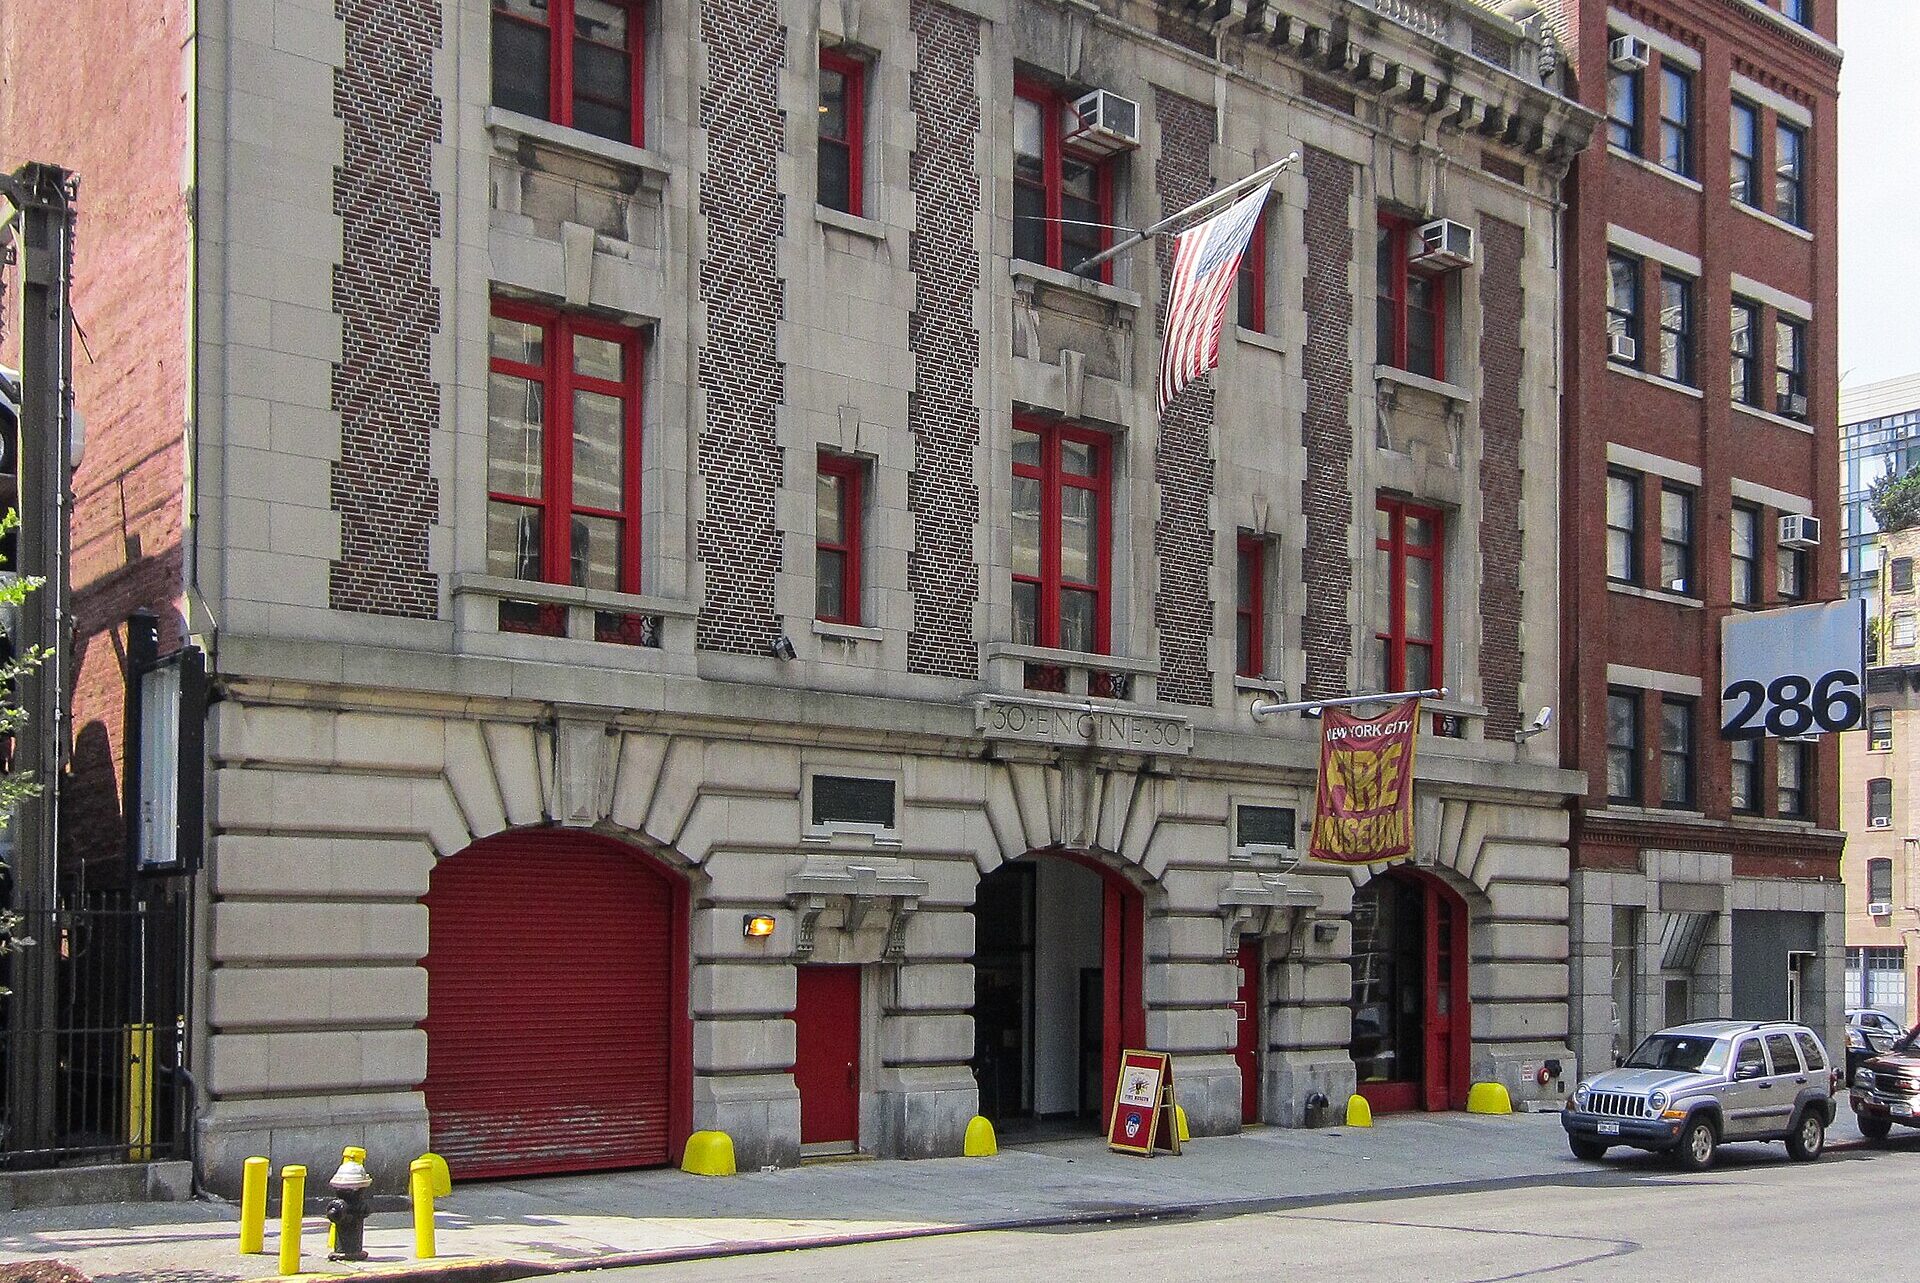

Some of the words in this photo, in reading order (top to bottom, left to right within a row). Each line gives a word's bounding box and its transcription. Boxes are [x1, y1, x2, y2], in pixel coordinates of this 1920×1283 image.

[1721, 669, 1861, 741] 286
[1326, 726, 1347, 742] NEW
[1348, 724, 1381, 738] YORK
[1384, 720, 1413, 735] CITY
[1315, 810, 1405, 854] MUSEUM
